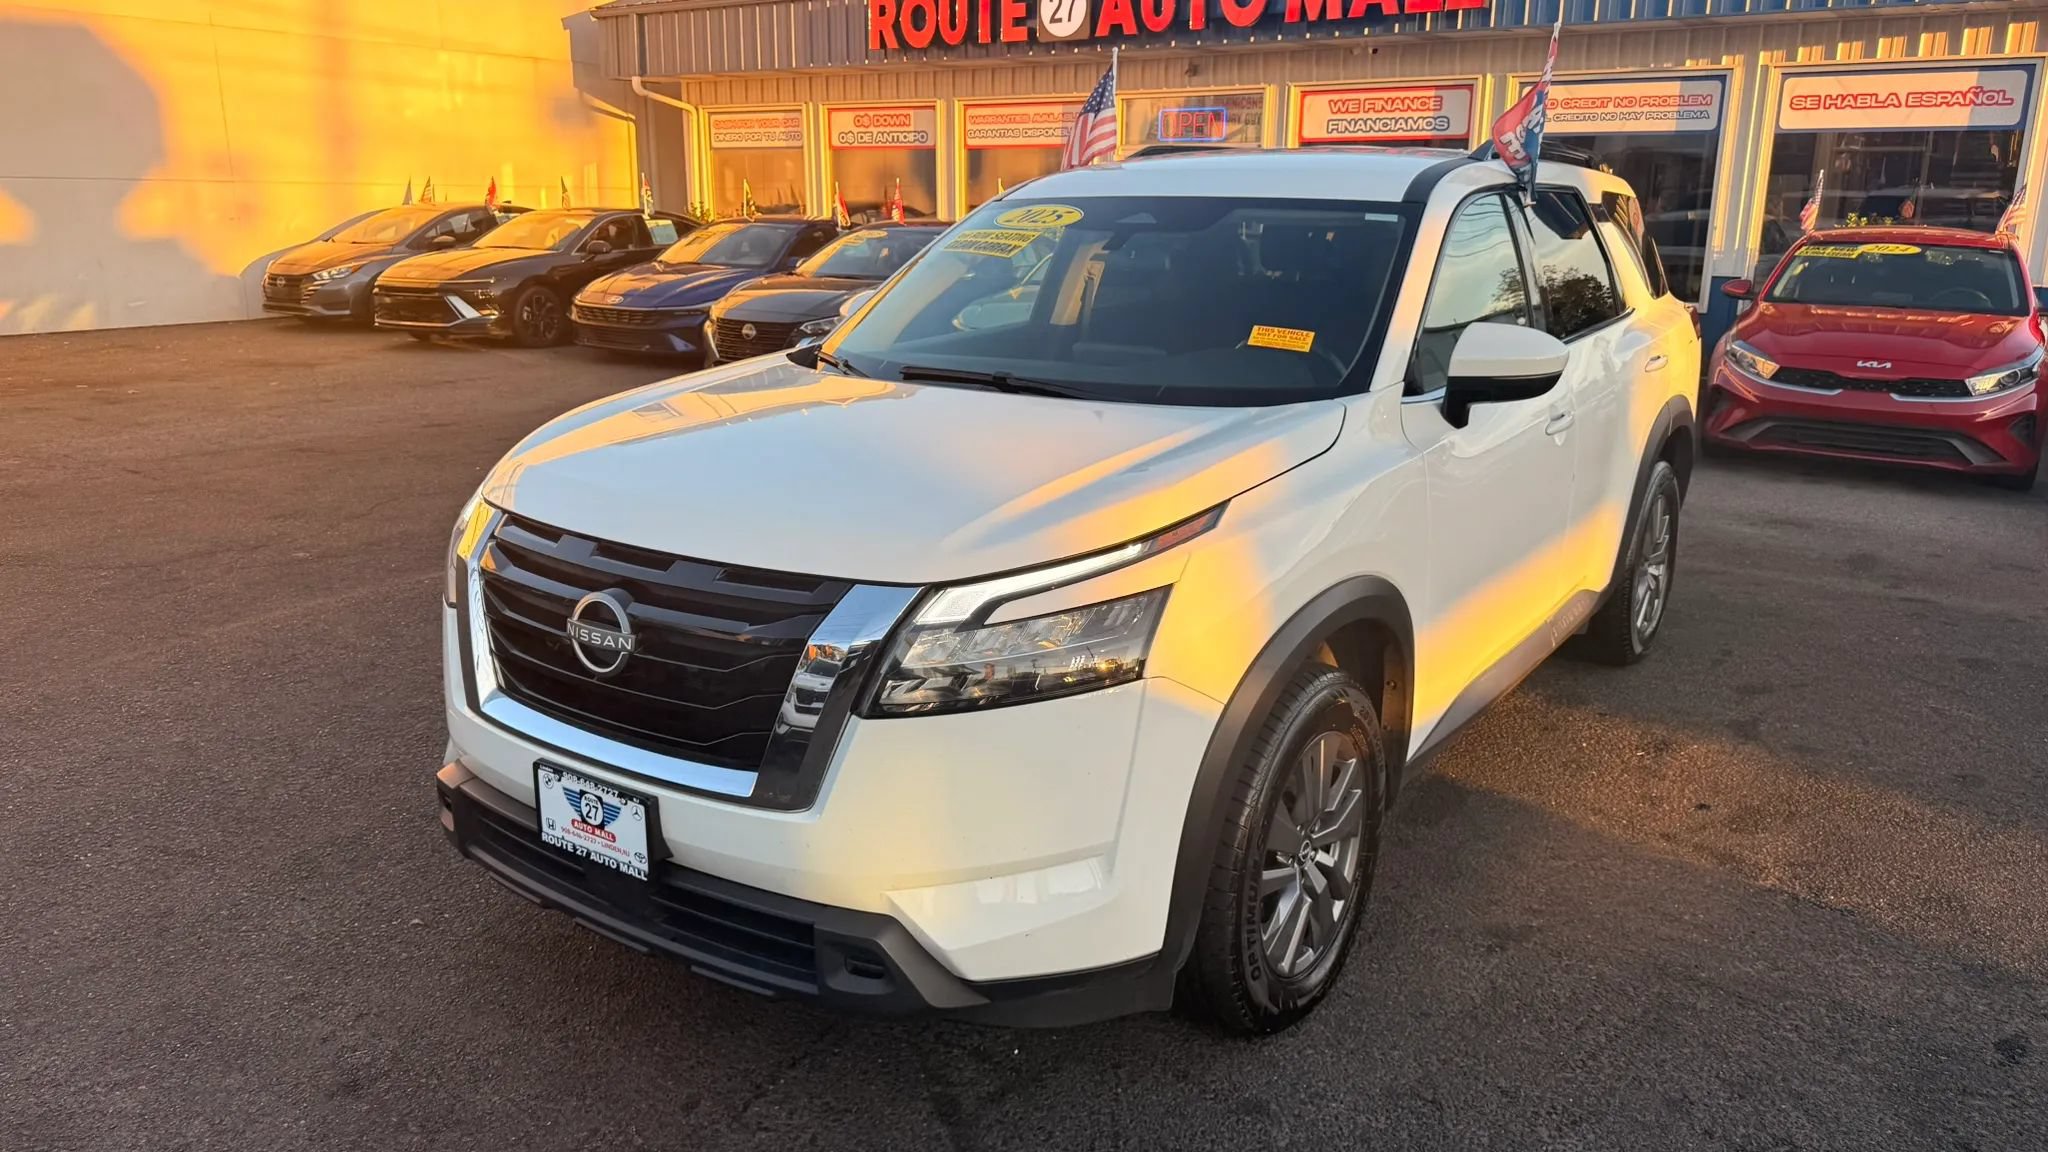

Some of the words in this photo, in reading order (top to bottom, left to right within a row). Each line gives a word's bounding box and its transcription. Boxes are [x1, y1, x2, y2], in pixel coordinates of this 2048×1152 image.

[868, 0, 1028, 49] ROUTE
[1048, 0, 1077, 25] 27
[1328, 98, 1361, 114] WE
[1363, 96, 1443, 113] FINANCE
[1561, 98, 1612, 110] CREDIT
[1613, 97, 1638, 109] NO
[1638, 94, 1713, 108] PROBLEM
[1789, 95, 1821, 110] SE
[1823, 92, 1902, 110] HABLA
[1905, 86, 2014, 107] ESPAÑOL
[873, 113, 911, 127] DOWN
[1161, 111, 1225, 138] OPEN
[1553, 112, 1598, 122] CREDITO
[1600, 111, 1619, 121] NO
[1619, 110, 1645, 121] HAY
[1645, 109, 1710, 120] PROBLEMA
[967, 129, 1020, 138] GARANTIAS
[1022, 127, 1071, 138] DISPONIBL
[1327, 116, 1450, 134] FINANCIAMOS
[778, 131, 801, 141] AUTO
[857, 131, 873, 144] DE
[875, 130, 928, 144] ANTICIPO
[567, 622, 632, 650] NISSAN
[585, 803, 599, 821] 27
[574, 821, 593, 833] AUTO
[594, 829, 614, 841] MALL
[542, 831, 574, 853] ROUTE
[576, 845, 588, 857] 27
[590, 851, 617, 869] AUTO
[620, 862, 648, 882] MALL
